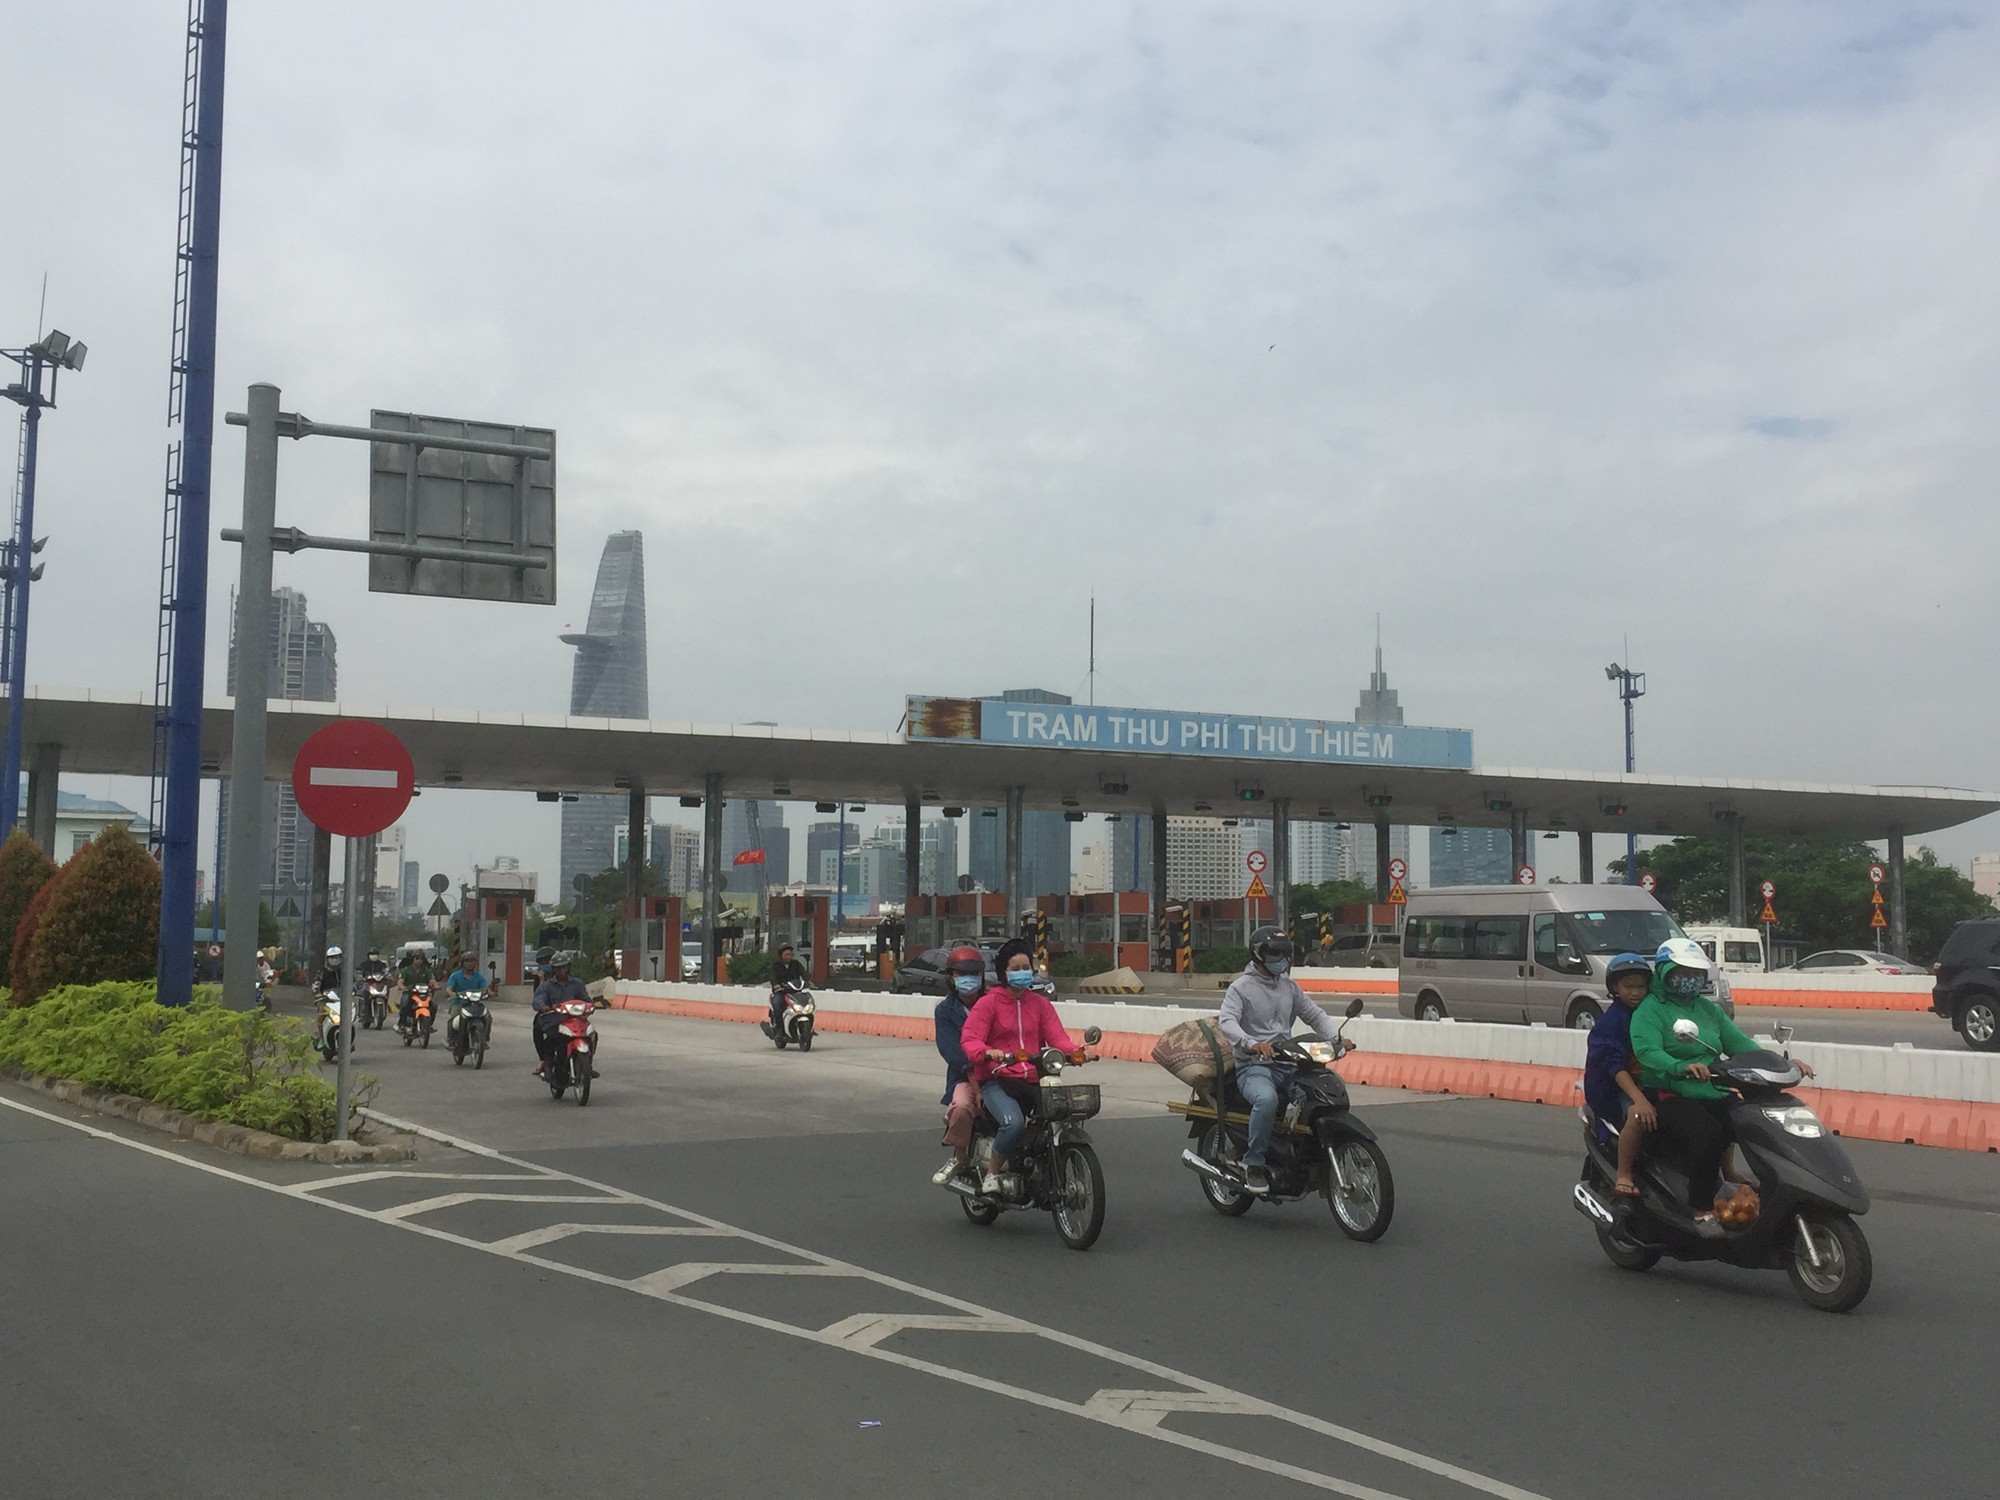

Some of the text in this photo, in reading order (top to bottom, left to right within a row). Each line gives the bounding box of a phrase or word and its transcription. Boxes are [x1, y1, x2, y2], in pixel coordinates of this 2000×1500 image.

[1006, 710, 1394, 759] TRẠM THU PHÍ THỦ THIÊM
